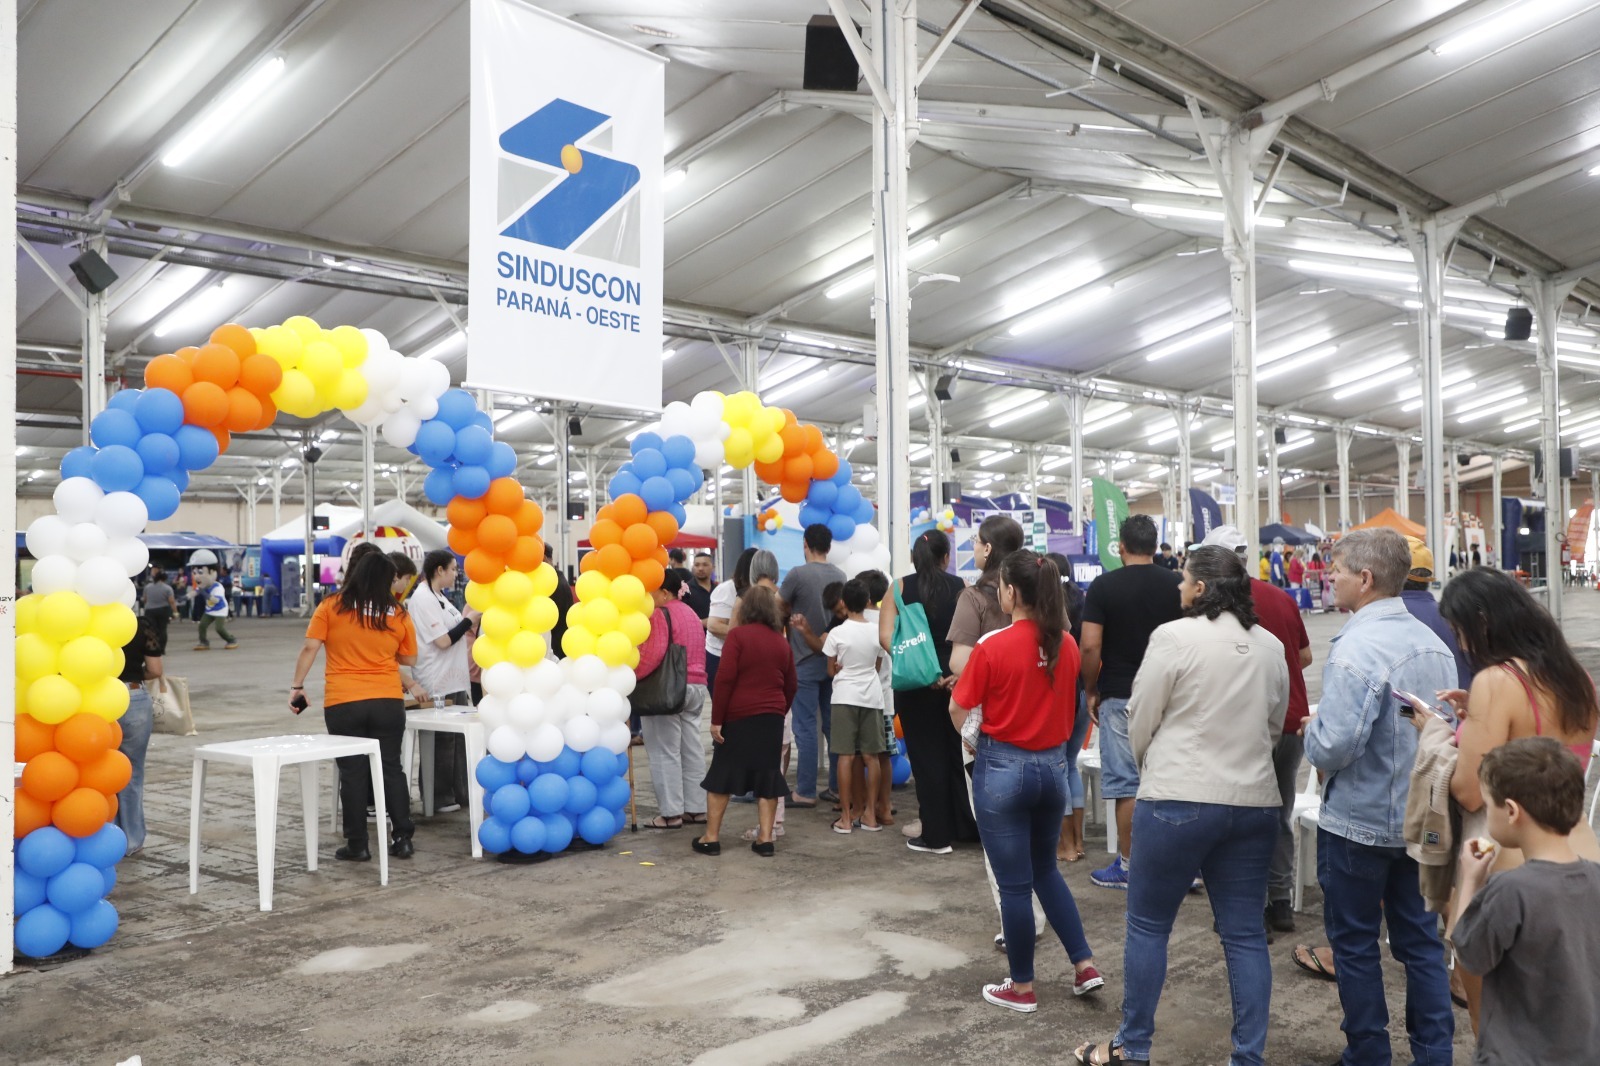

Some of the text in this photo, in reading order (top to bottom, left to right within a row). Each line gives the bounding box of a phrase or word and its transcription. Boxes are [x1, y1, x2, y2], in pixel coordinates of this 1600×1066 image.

[497, 251, 641, 306] SINDUSCON
[497, 287, 571, 320] PARANÁ
[586, 306, 640, 333] OESTE
